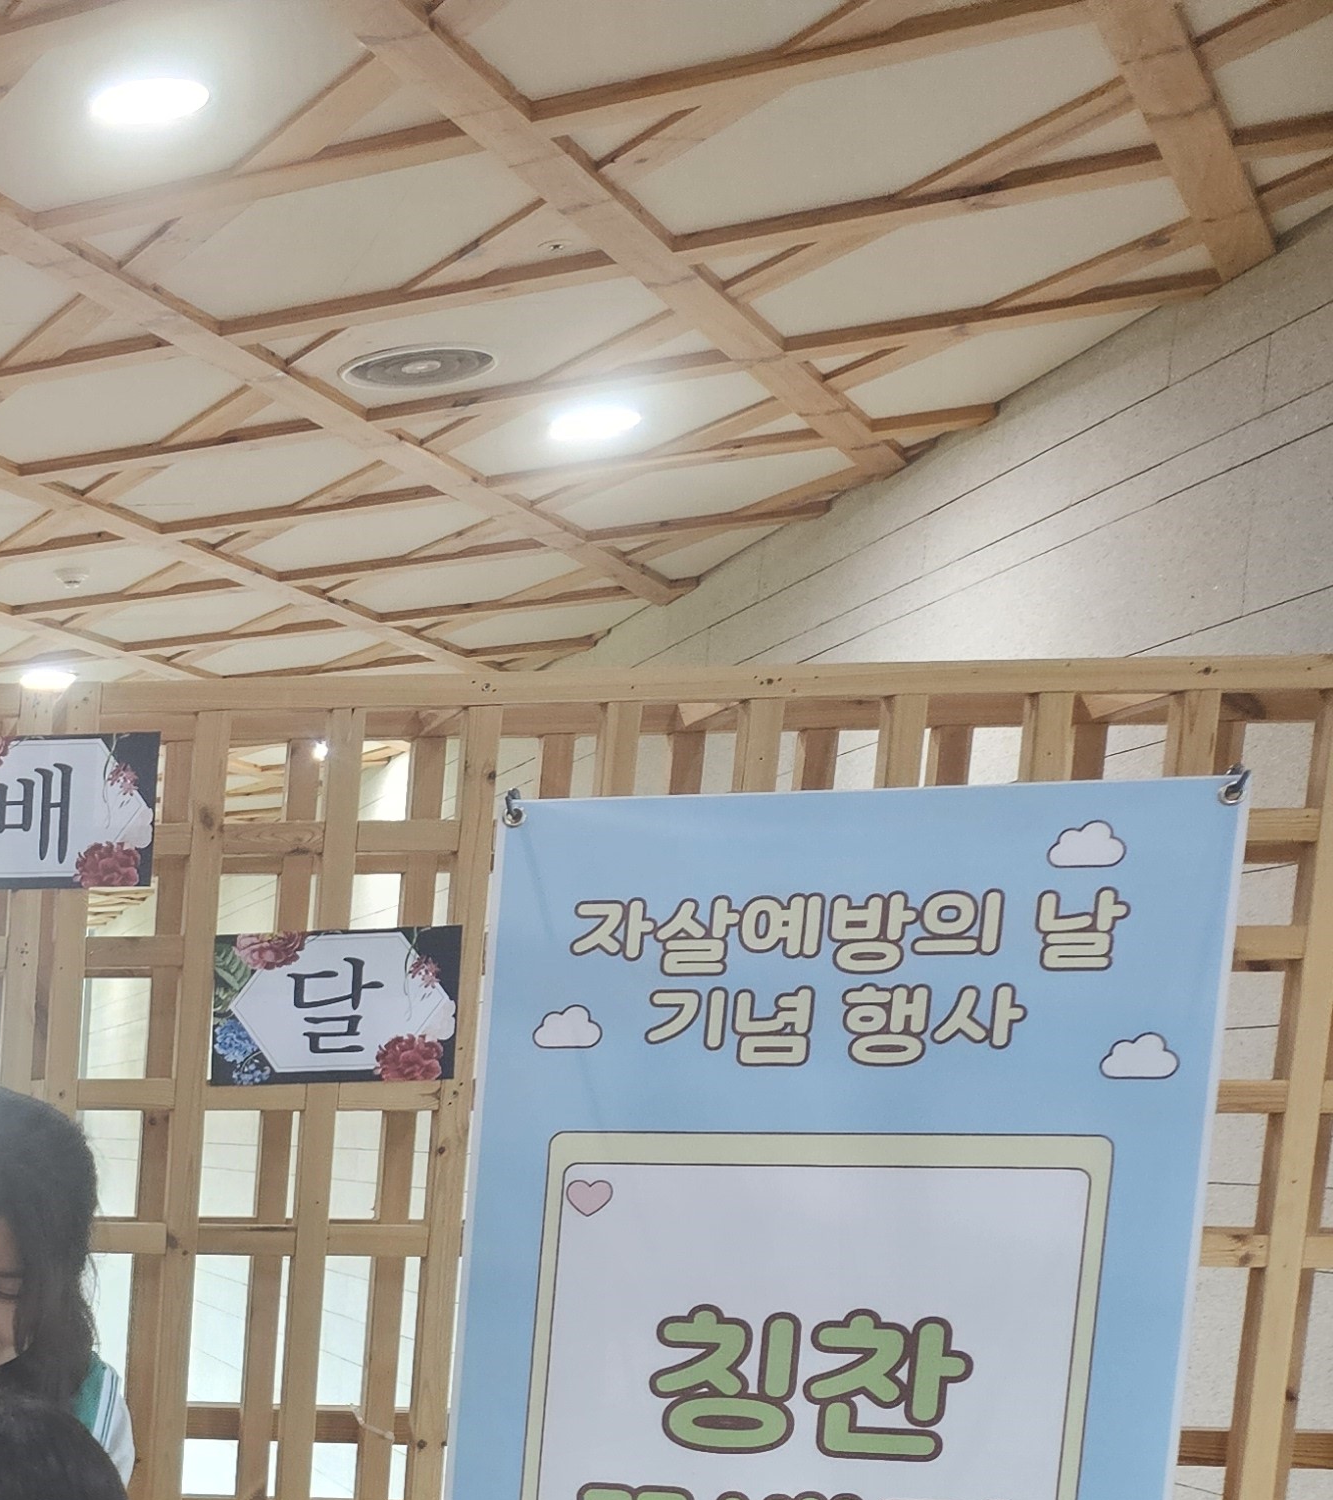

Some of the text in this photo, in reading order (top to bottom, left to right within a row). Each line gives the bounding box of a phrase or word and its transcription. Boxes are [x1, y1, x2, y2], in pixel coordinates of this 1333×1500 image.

[570, 882, 1130, 976] 자살예방의 날
[285, 956, 385, 1054] 달
[645, 982, 1027, 1067] 기념 행사
[649, 1303, 974, 1462] 칭찬
